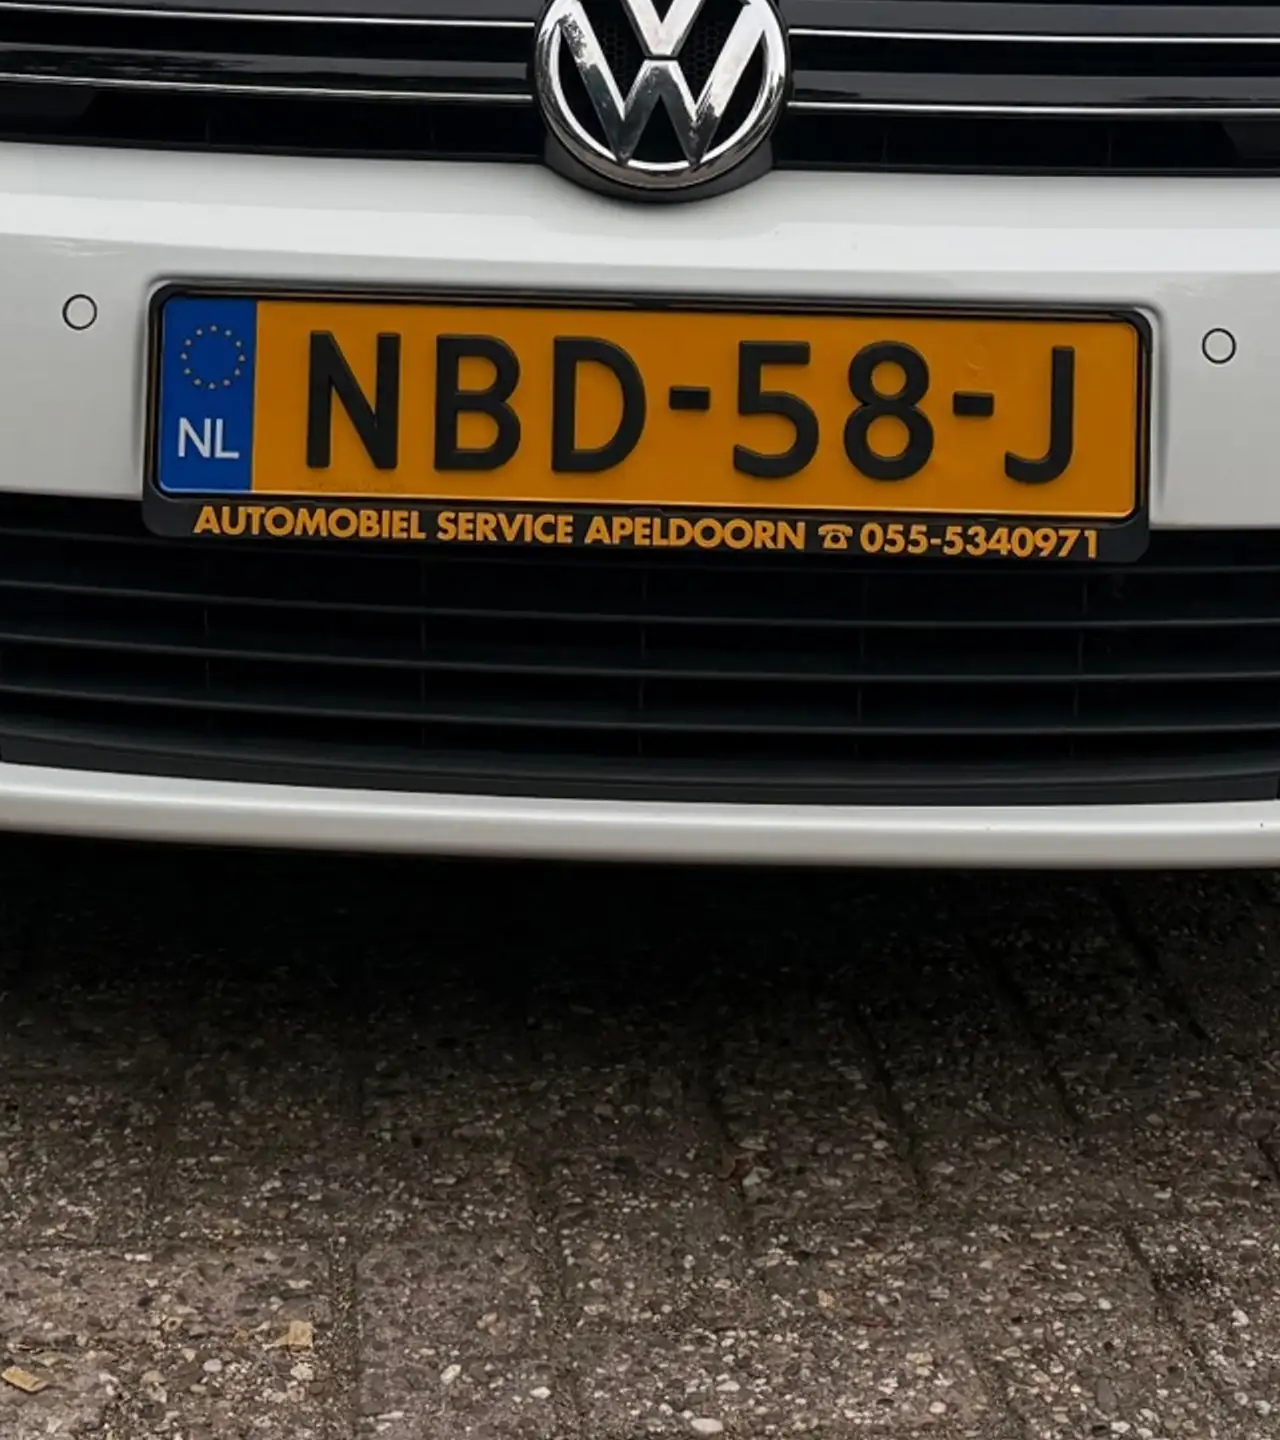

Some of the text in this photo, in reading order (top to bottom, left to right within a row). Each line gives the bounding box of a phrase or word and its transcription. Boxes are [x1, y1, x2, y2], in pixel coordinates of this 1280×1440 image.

[306, 328, 1075, 485] NBD-58-J
[177, 416, 240, 460] NL
[193, 505, 1098, 560] AUTOMOBIEL SERVICE APELDOORN 055-5340971
